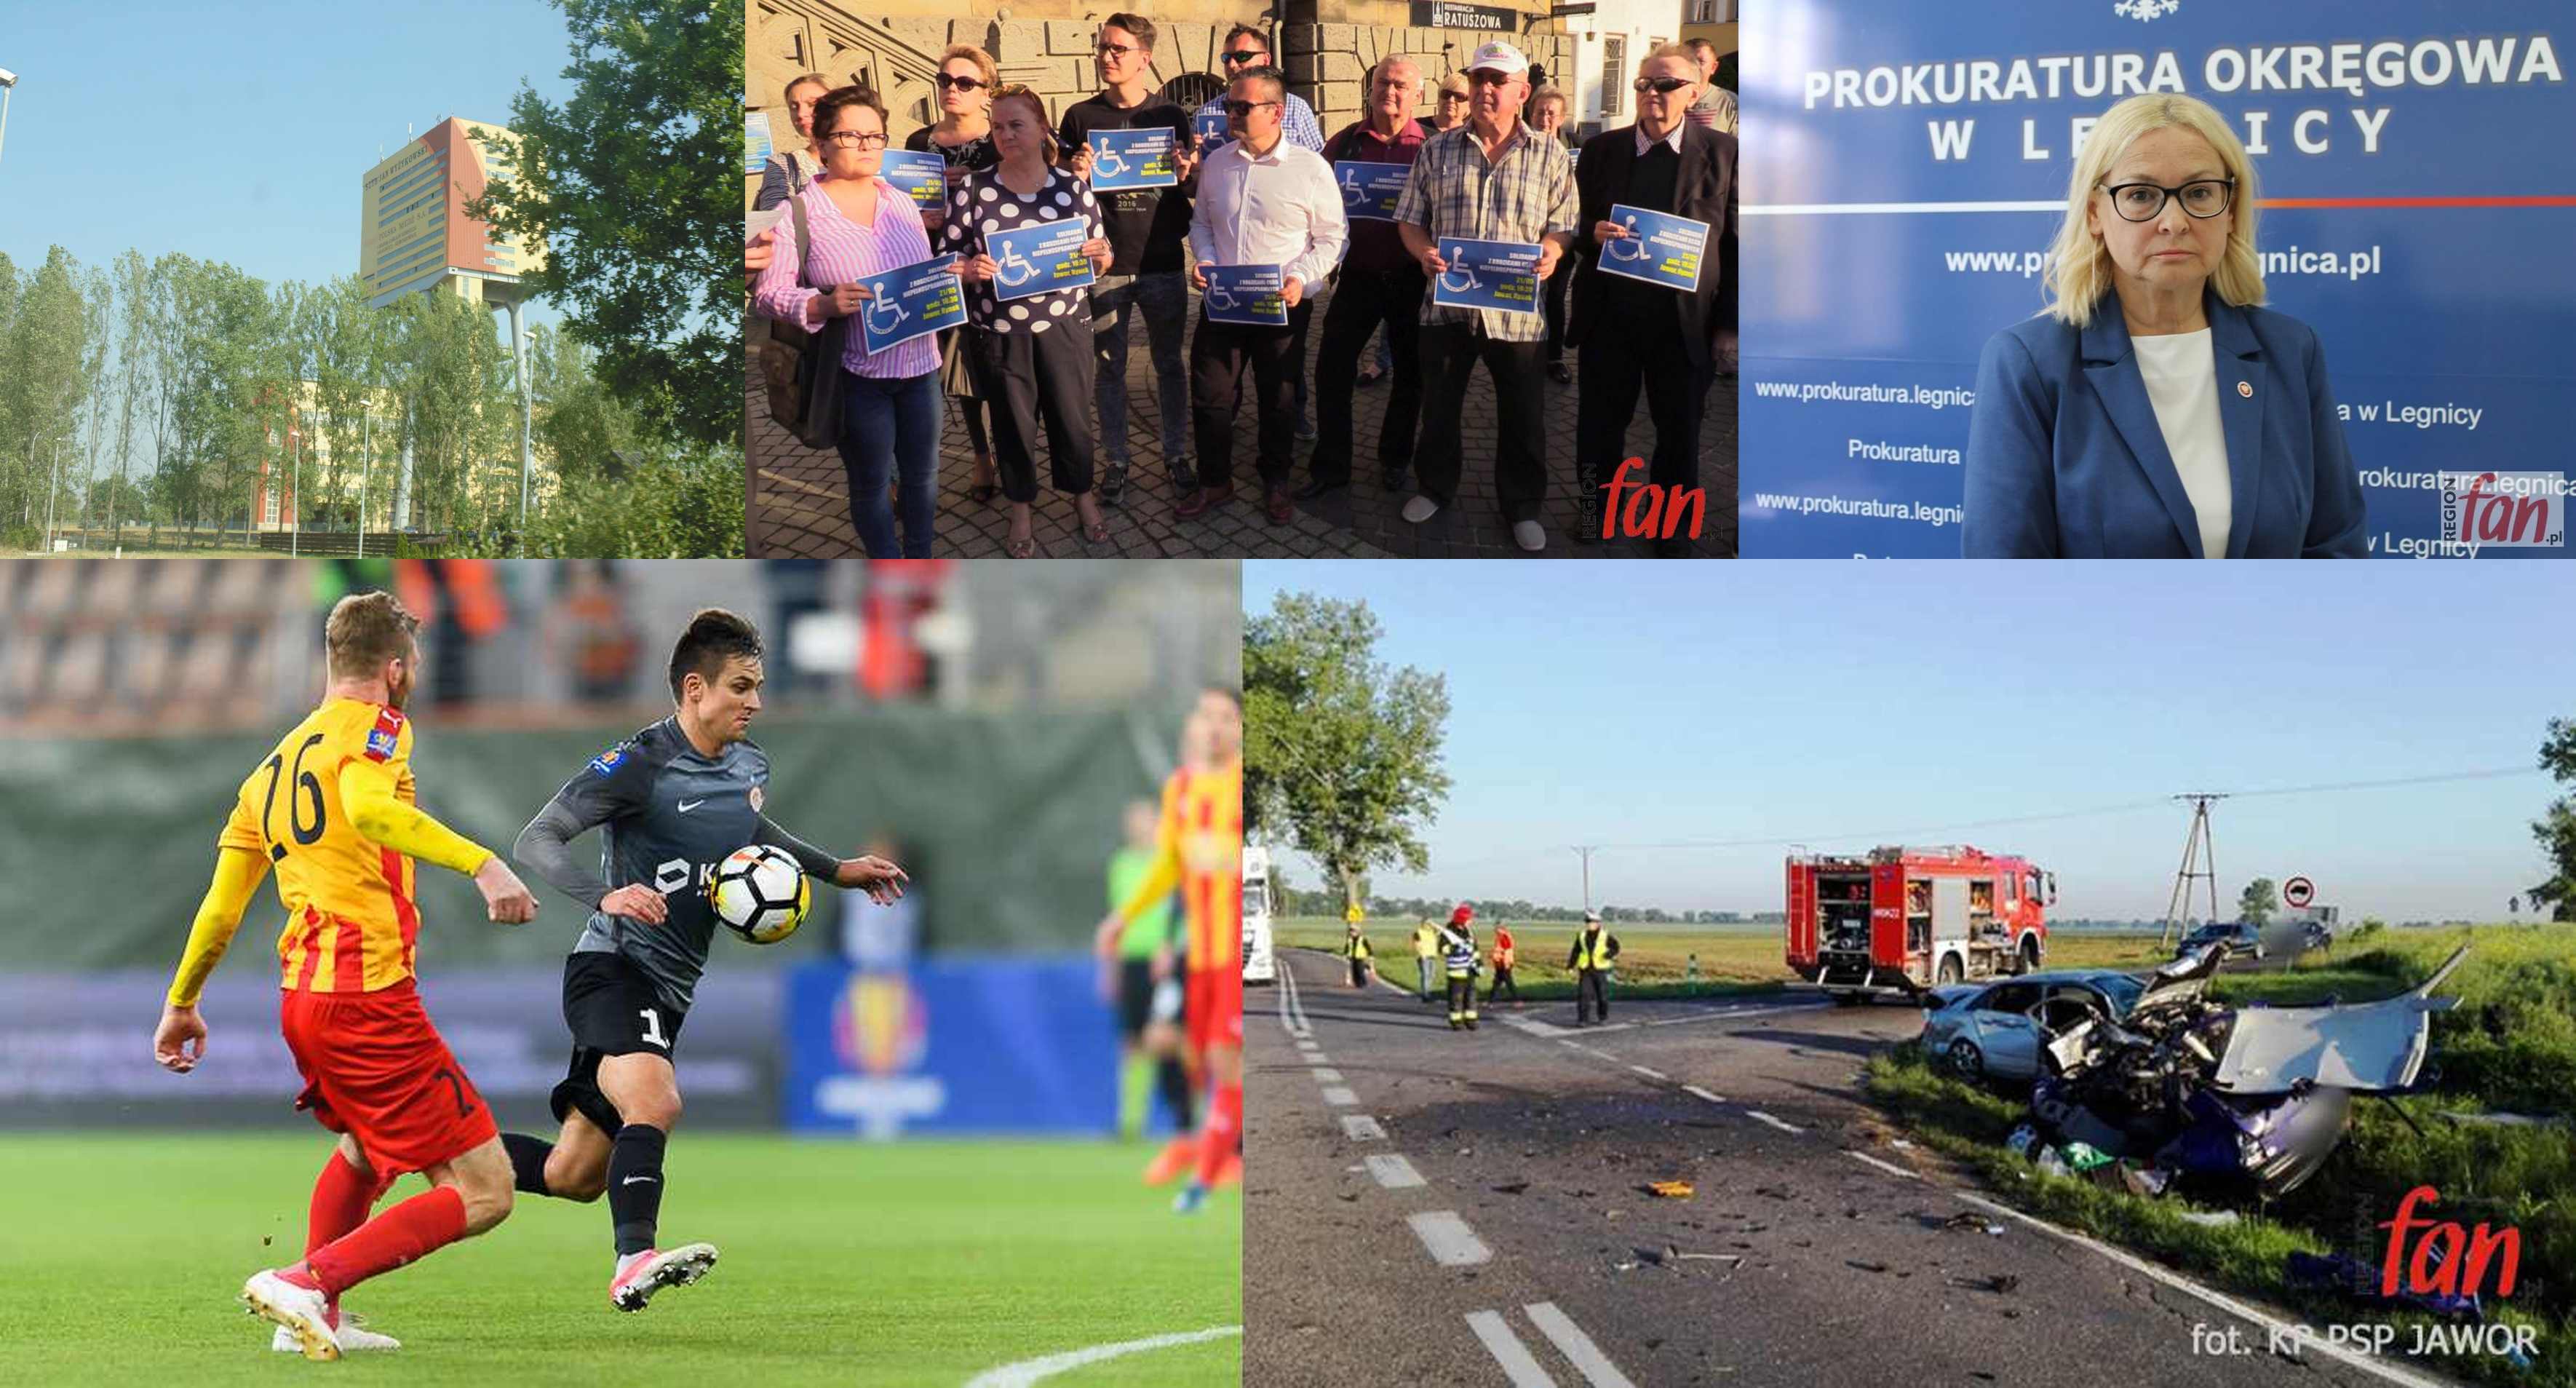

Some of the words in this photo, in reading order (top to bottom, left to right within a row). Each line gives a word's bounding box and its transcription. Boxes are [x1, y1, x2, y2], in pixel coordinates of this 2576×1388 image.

[1444, 3, 1474, 12] RESTAURACJA
[1444, 11, 1501, 29] RATUSZOWA
[1804, 51, 2185, 110] PROKURATURA
[2205, 36, 2563, 97] OKRĘGOWA
[1927, 119, 1975, 161] W
[2358, 405, 2379, 421] w
[2386, 401, 2483, 430] Legnicy
[1848, 439, 1960, 464] Prokuratura
[2358, 467, 2576, 499] rokuratura.legnica
[1756, 493, 1964, 526] www.prokuratura.legni
[2385, 532, 2480, 559] Legnicy
[263, 733, 326, 863] 26
[640, 1008, 670, 1049] 1
